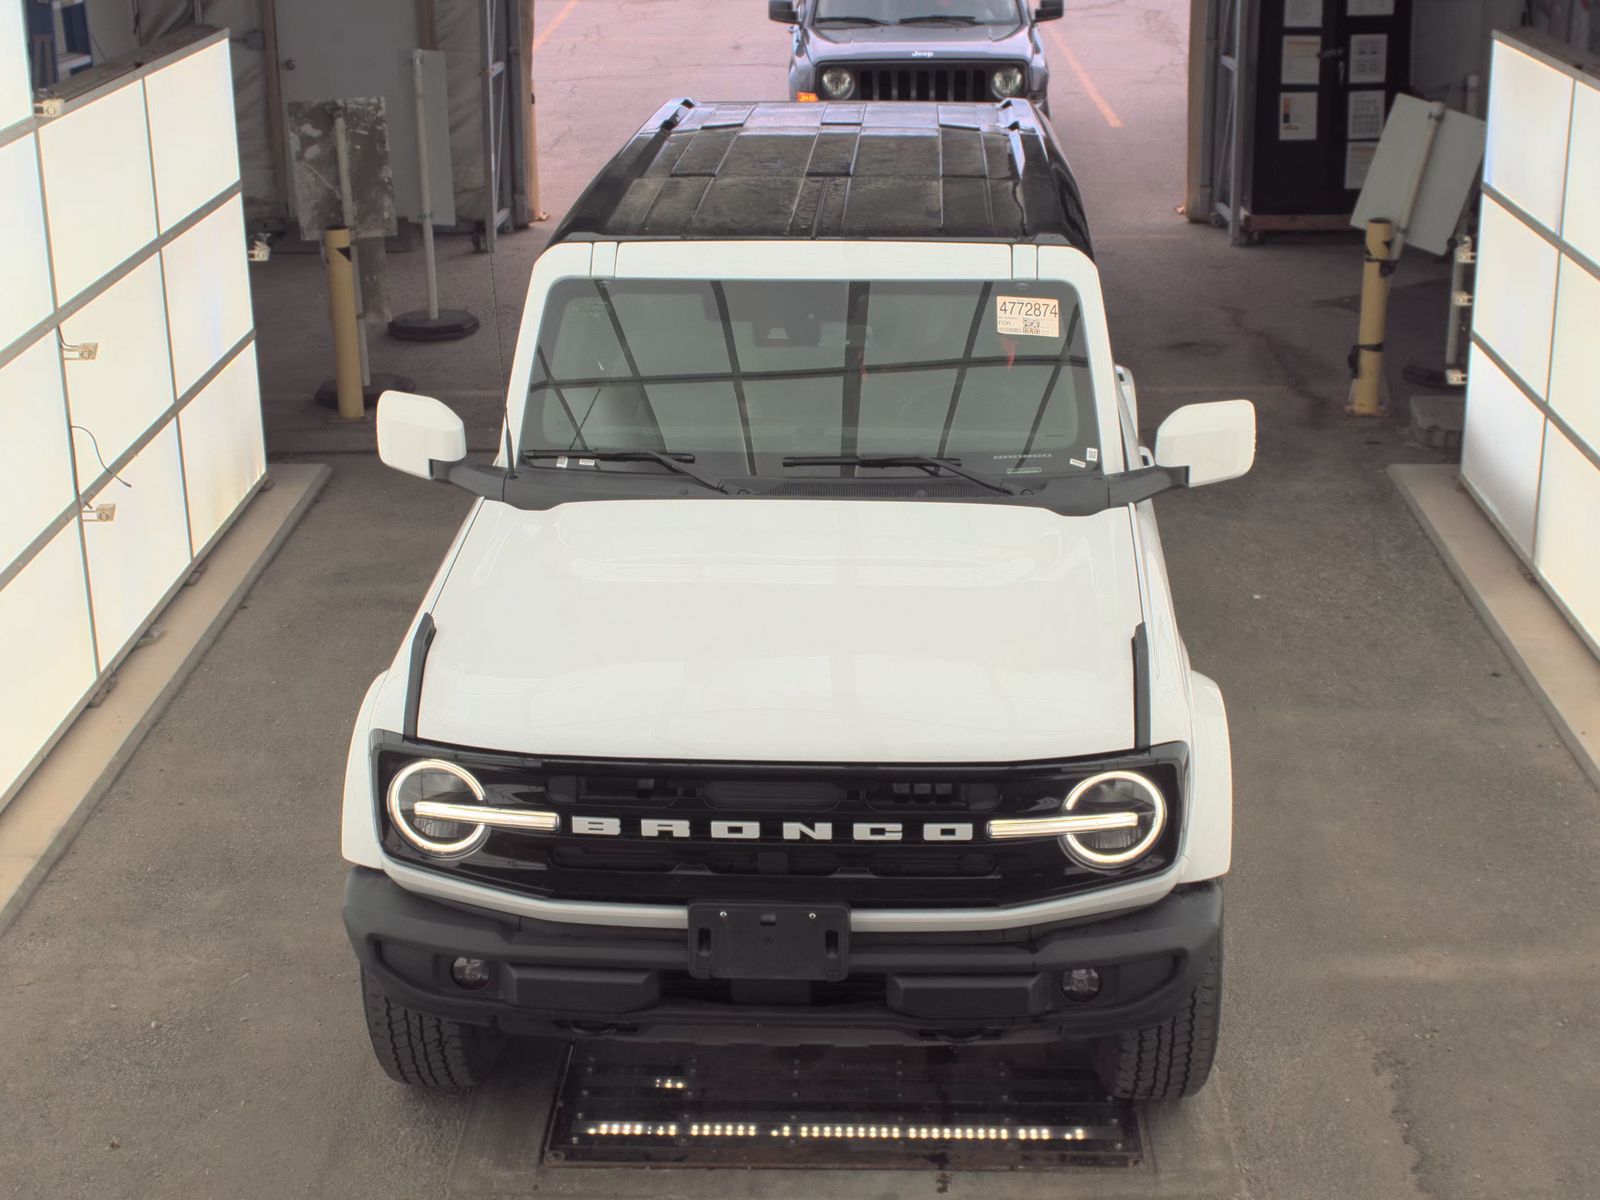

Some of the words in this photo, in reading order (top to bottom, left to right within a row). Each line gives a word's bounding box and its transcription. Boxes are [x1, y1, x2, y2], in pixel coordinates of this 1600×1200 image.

[912, 50, 934, 58] Jeep
[999, 301, 1058, 318] 4772874
[572, 815, 973, 841] BRONCO
